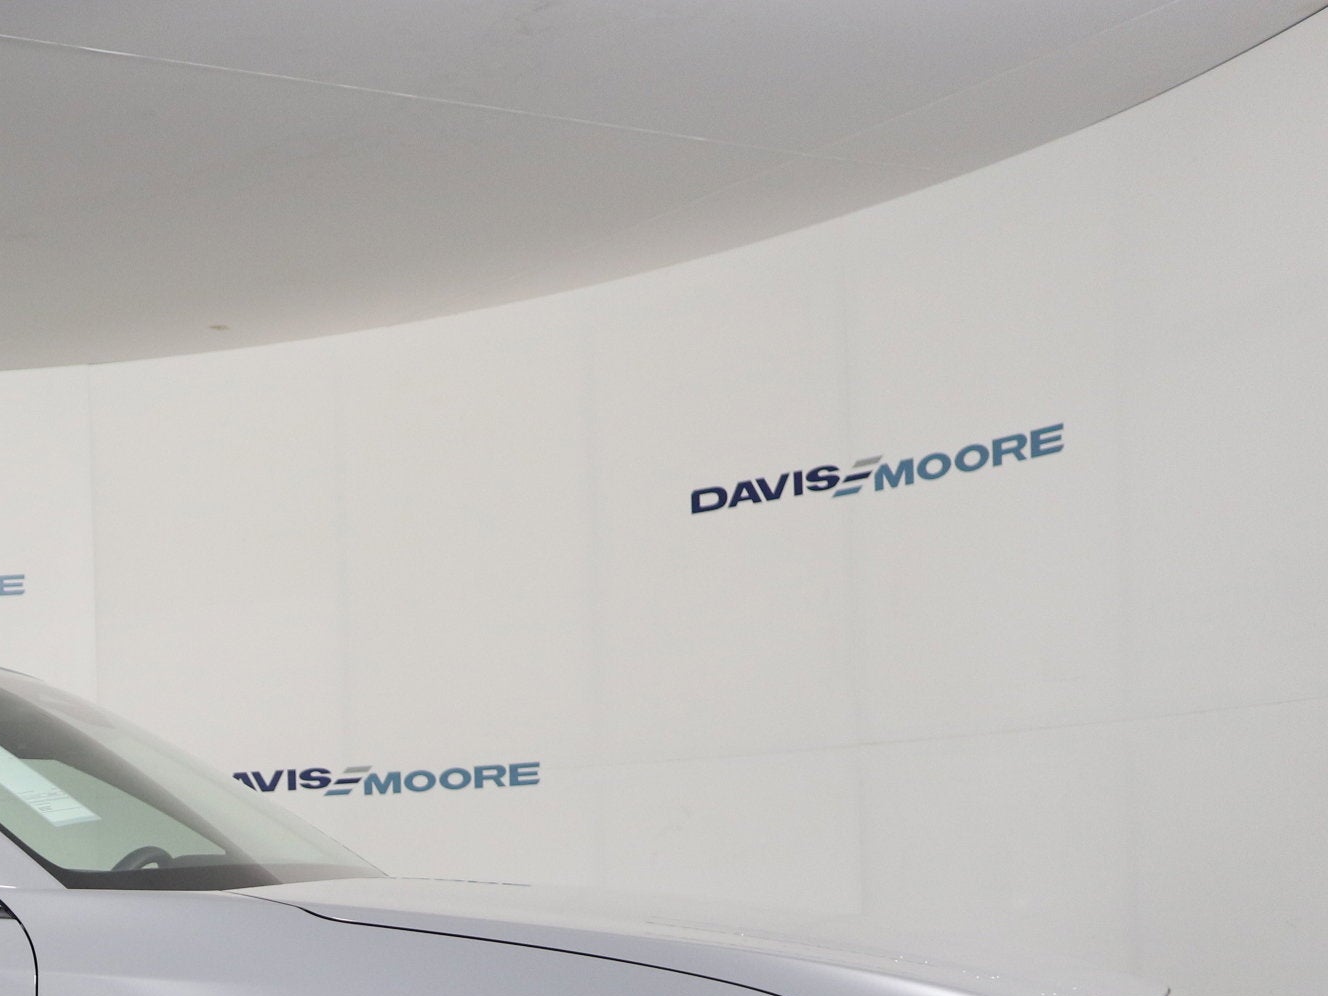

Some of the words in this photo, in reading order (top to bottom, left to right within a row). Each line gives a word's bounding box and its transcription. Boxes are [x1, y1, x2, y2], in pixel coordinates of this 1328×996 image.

[691, 464, 840, 515] DAVIS
[874, 422, 1064, 492] MOORE
[363, 761, 540, 796] MOORE
